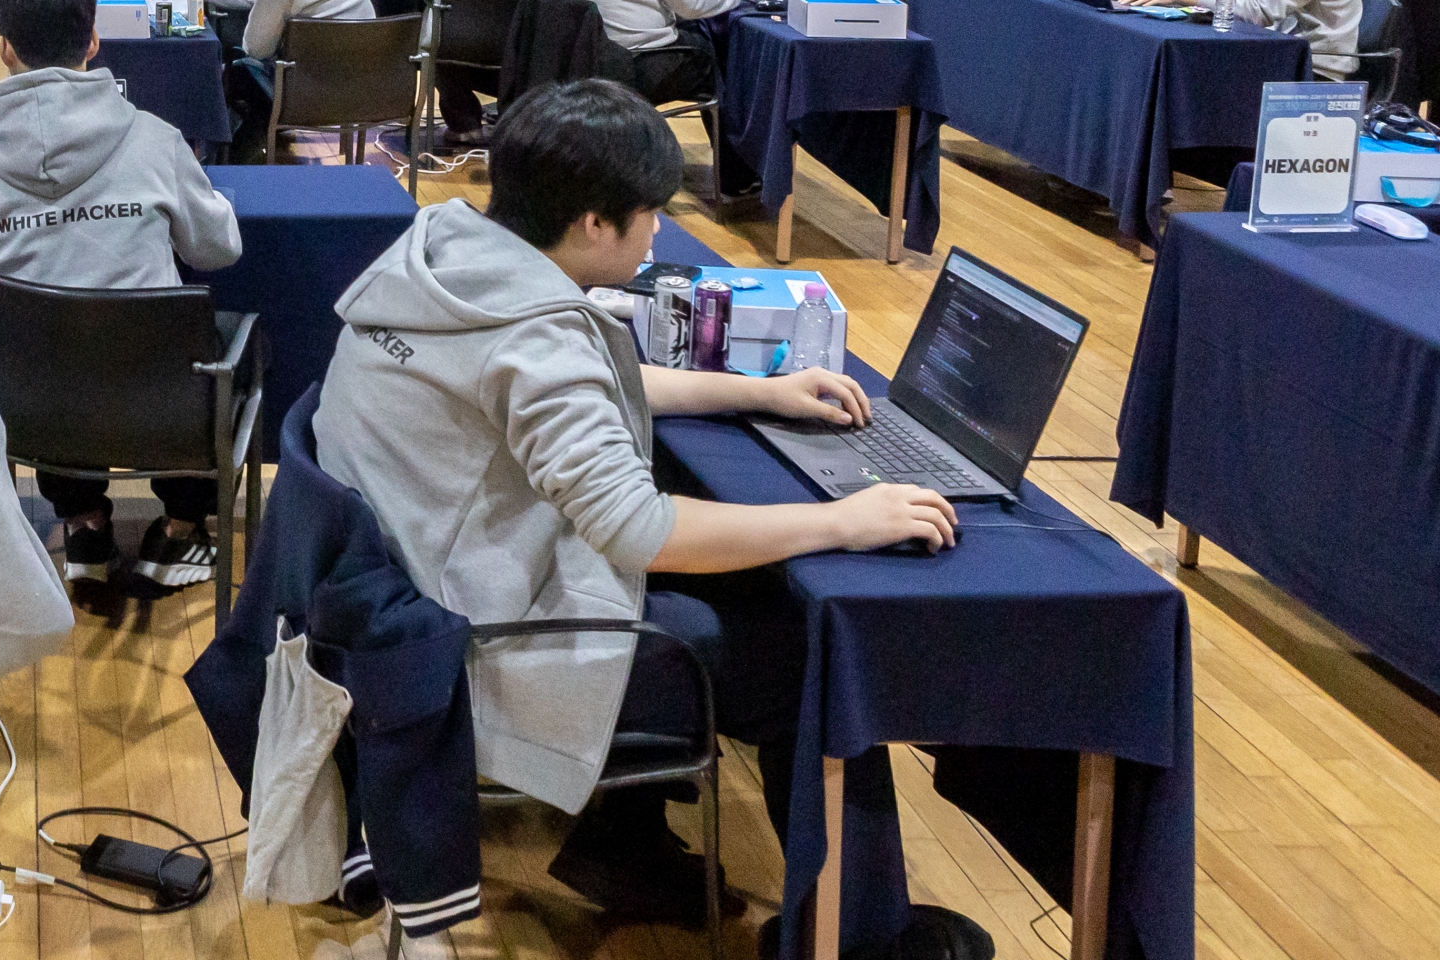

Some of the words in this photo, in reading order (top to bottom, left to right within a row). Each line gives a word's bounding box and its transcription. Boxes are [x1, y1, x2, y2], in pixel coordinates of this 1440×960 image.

[1264, 158, 1350, 174] HEXAGON
[62, 202, 143, 223] HACKER
[368, 326, 415, 365] CKER
